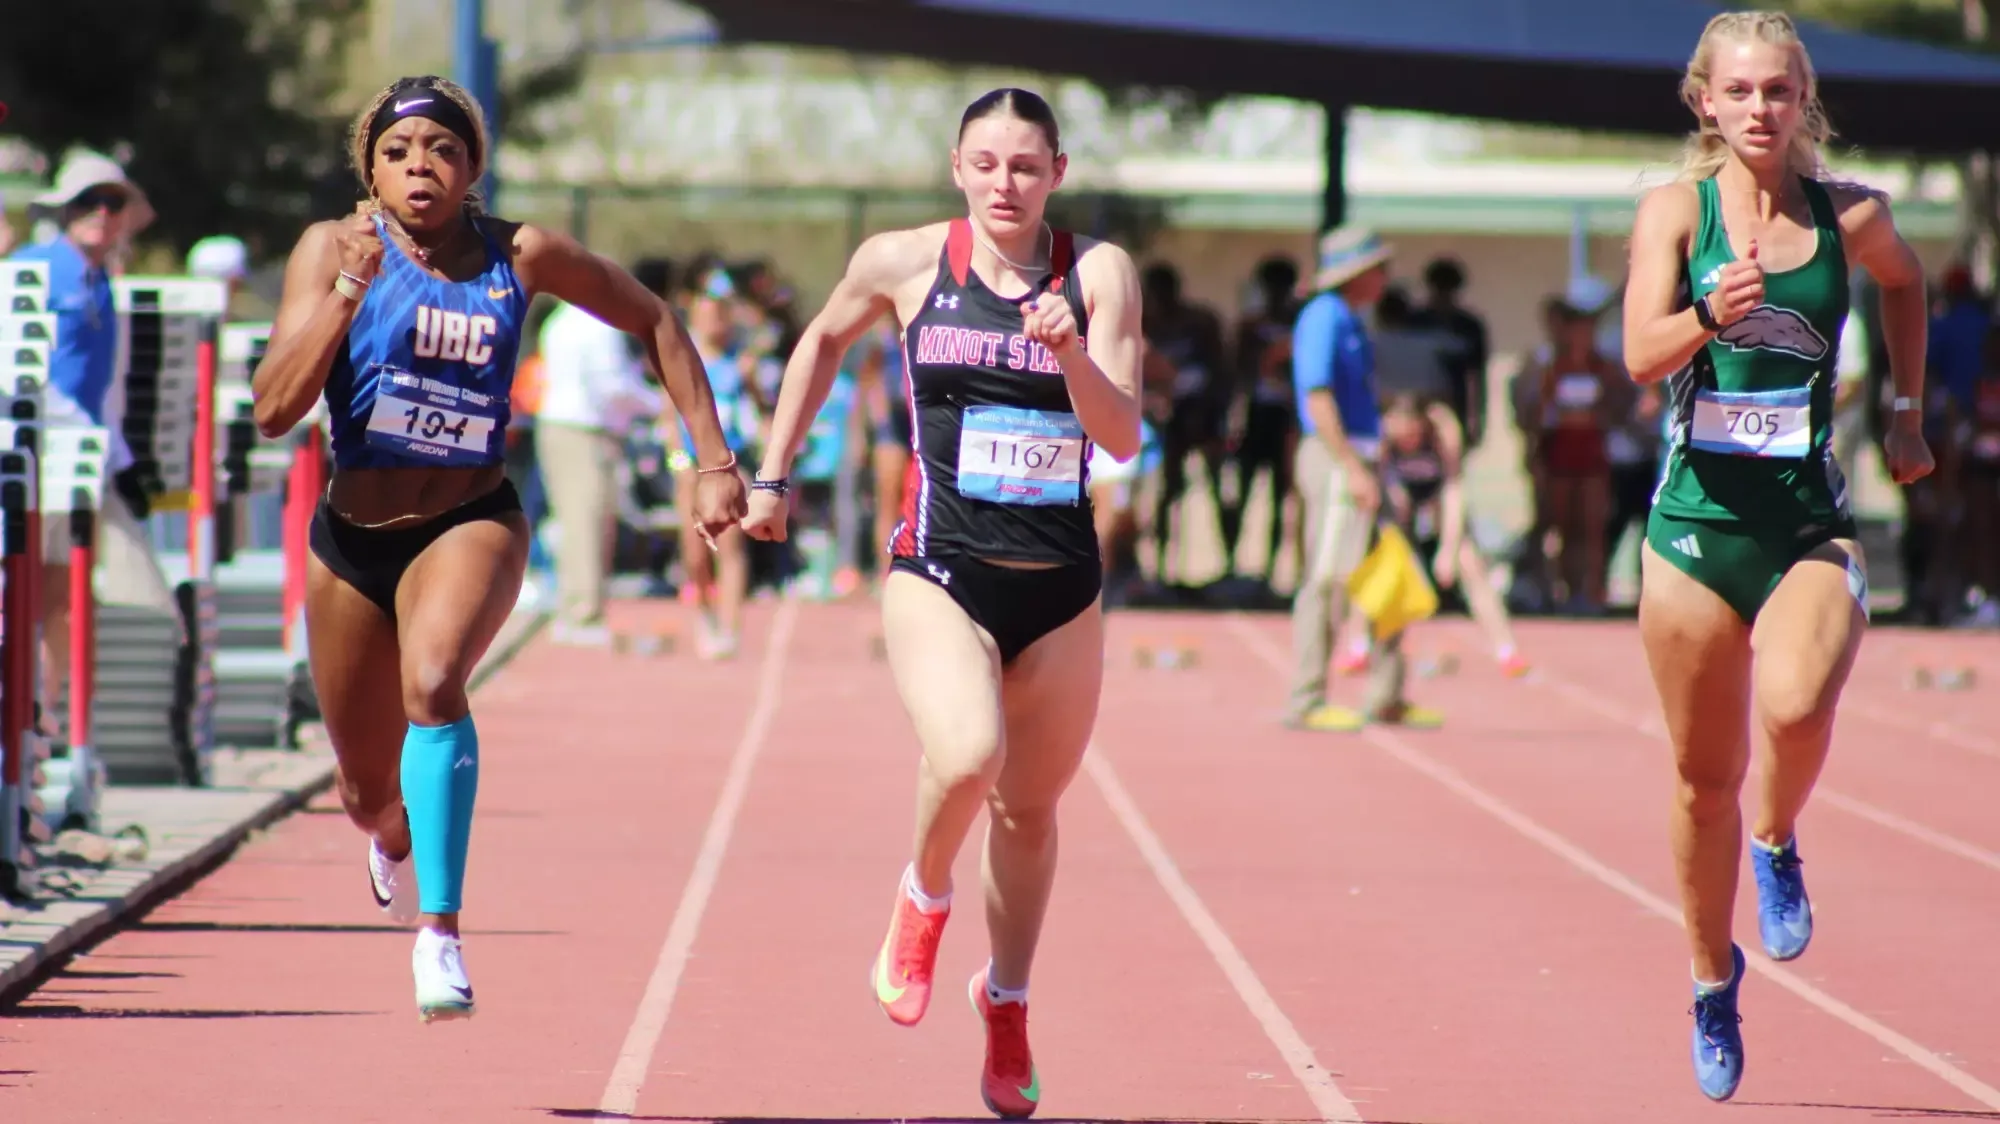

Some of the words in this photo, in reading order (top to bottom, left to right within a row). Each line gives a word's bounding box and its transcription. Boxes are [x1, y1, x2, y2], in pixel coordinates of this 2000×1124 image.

[414, 304, 497, 366] UBC
[916, 324, 1004, 367] MINOT
[1008, 334, 1085, 375] STA
[421, 377, 460, 399] Williams
[461, 387, 491, 407] Classic
[404, 406, 469, 444] 194
[1727, 411, 1780, 436] 705
[406, 441, 449, 457] ARIZONA
[990, 439, 1062, 470] 1167
